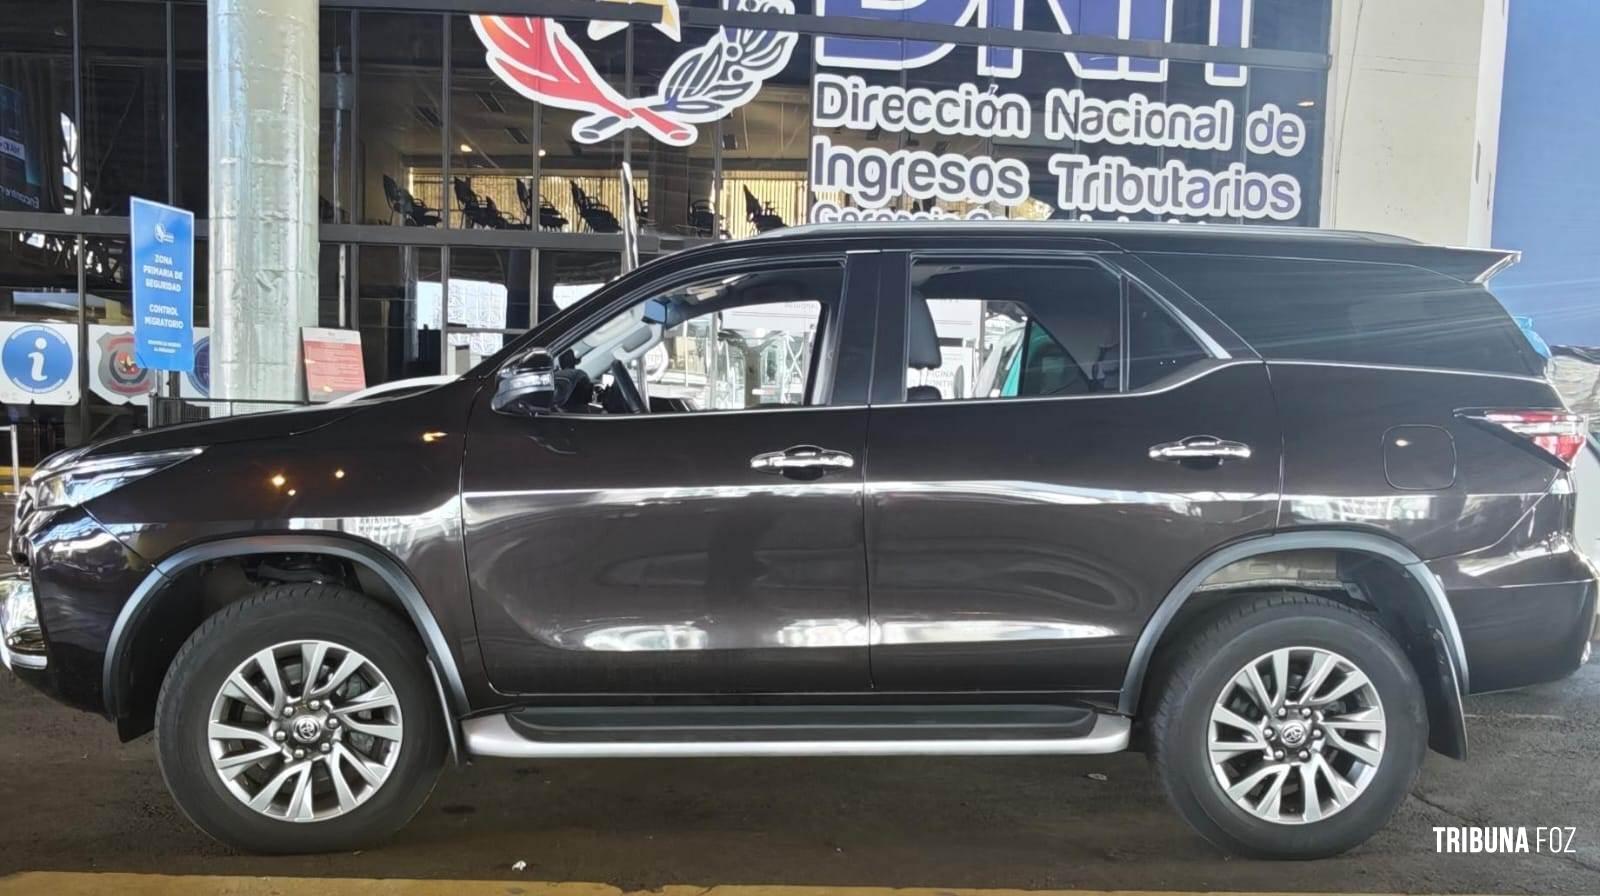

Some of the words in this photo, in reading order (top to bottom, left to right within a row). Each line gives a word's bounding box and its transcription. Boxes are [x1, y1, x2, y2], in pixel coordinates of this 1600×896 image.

[814, 77, 1028, 136] Dirección
[1048, 91, 1232, 148] Nacional
[1246, 106, 1304, 153] de
[811, 139, 1028, 205] Ingresos
[1051, 156, 1300, 216] Tributarios
[155, 253, 173, 266] ZONA
[143, 265, 173, 278] PRIMARIA
[174, 270, 184, 281] DE
[145, 278, 182, 293] SEGURIDAD
[149, 304, 179, 316] CONTROL
[144, 316, 185, 329] MIGRATORIO
